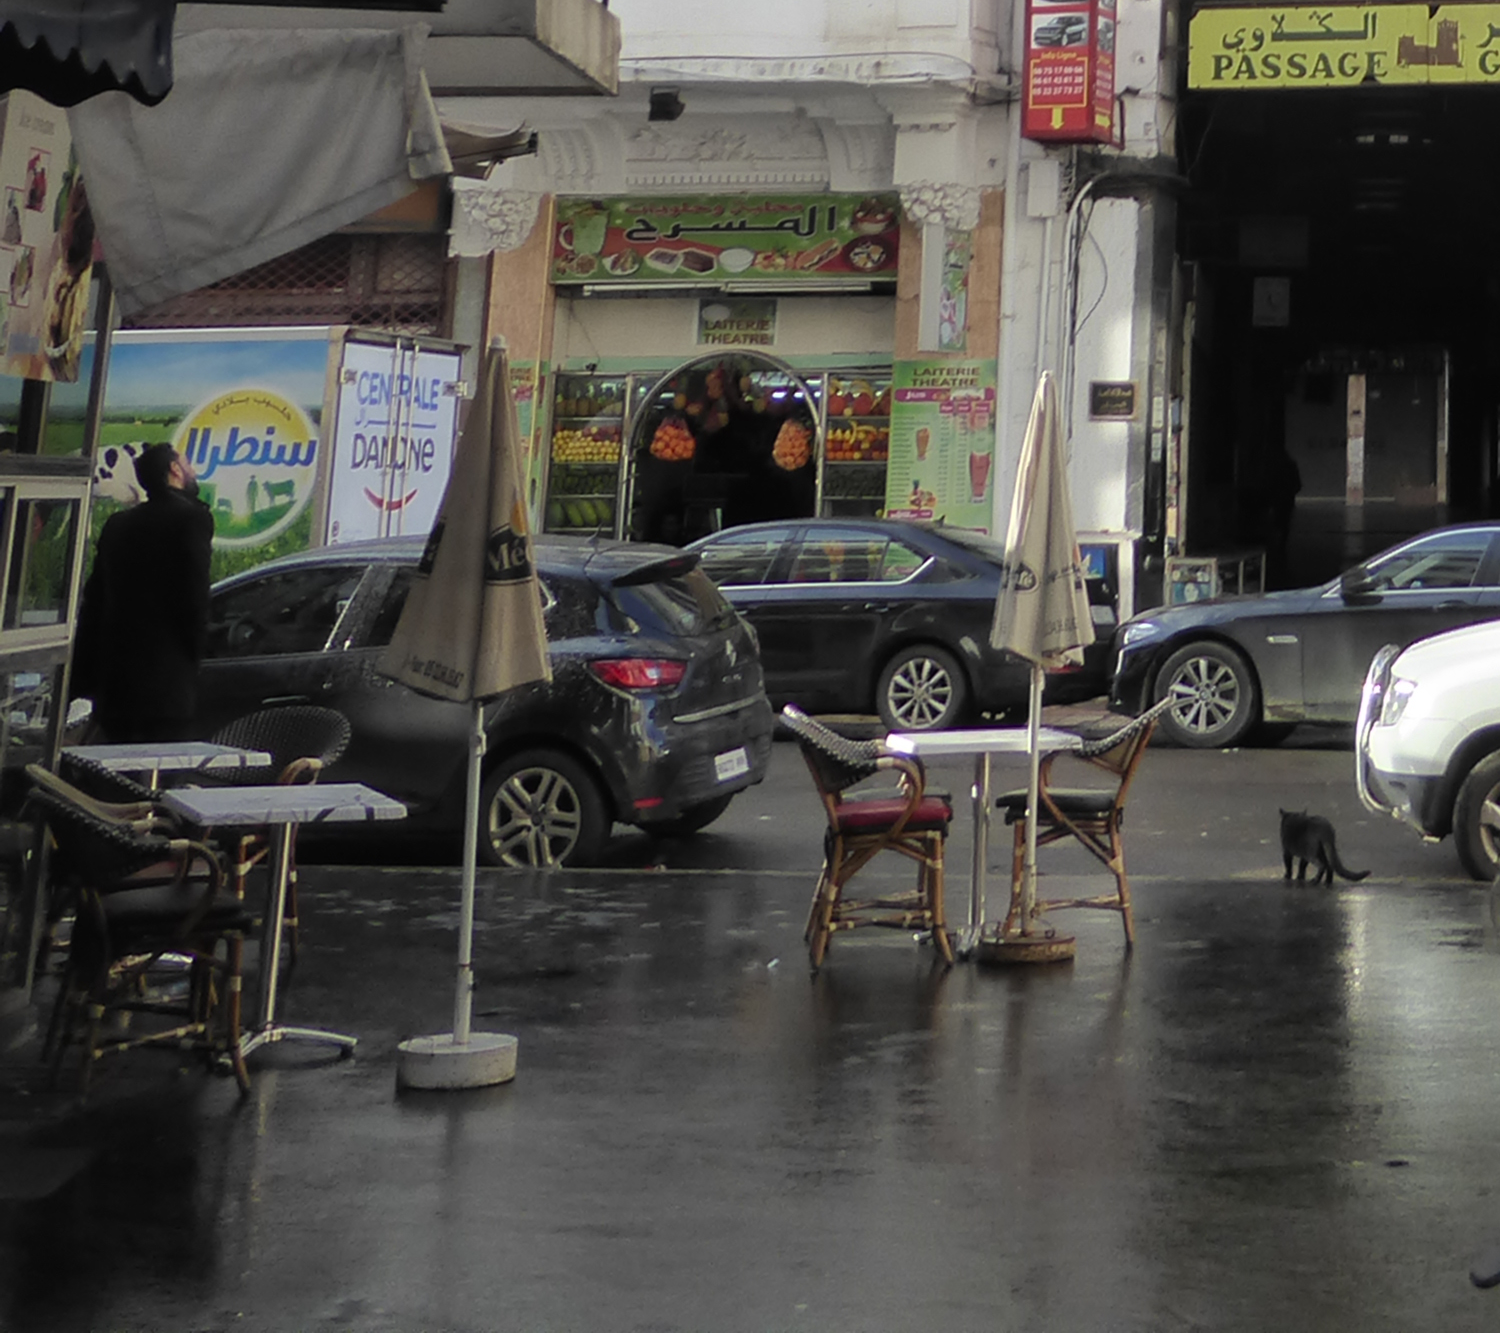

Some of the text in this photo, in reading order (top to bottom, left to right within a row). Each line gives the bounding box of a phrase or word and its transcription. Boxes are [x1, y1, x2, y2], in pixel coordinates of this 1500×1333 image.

[1211, 50, 1389, 81] PASSAGE
[623, 203, 838, 242] المسرح
[704, 318, 770, 331] LAITERIE
[703, 333, 770, 345] THEATRE
[913, 367, 980, 377] LAITERIE
[911, 377, 978, 387] THEATRE
[357, 370, 441, 412] CENRALE
